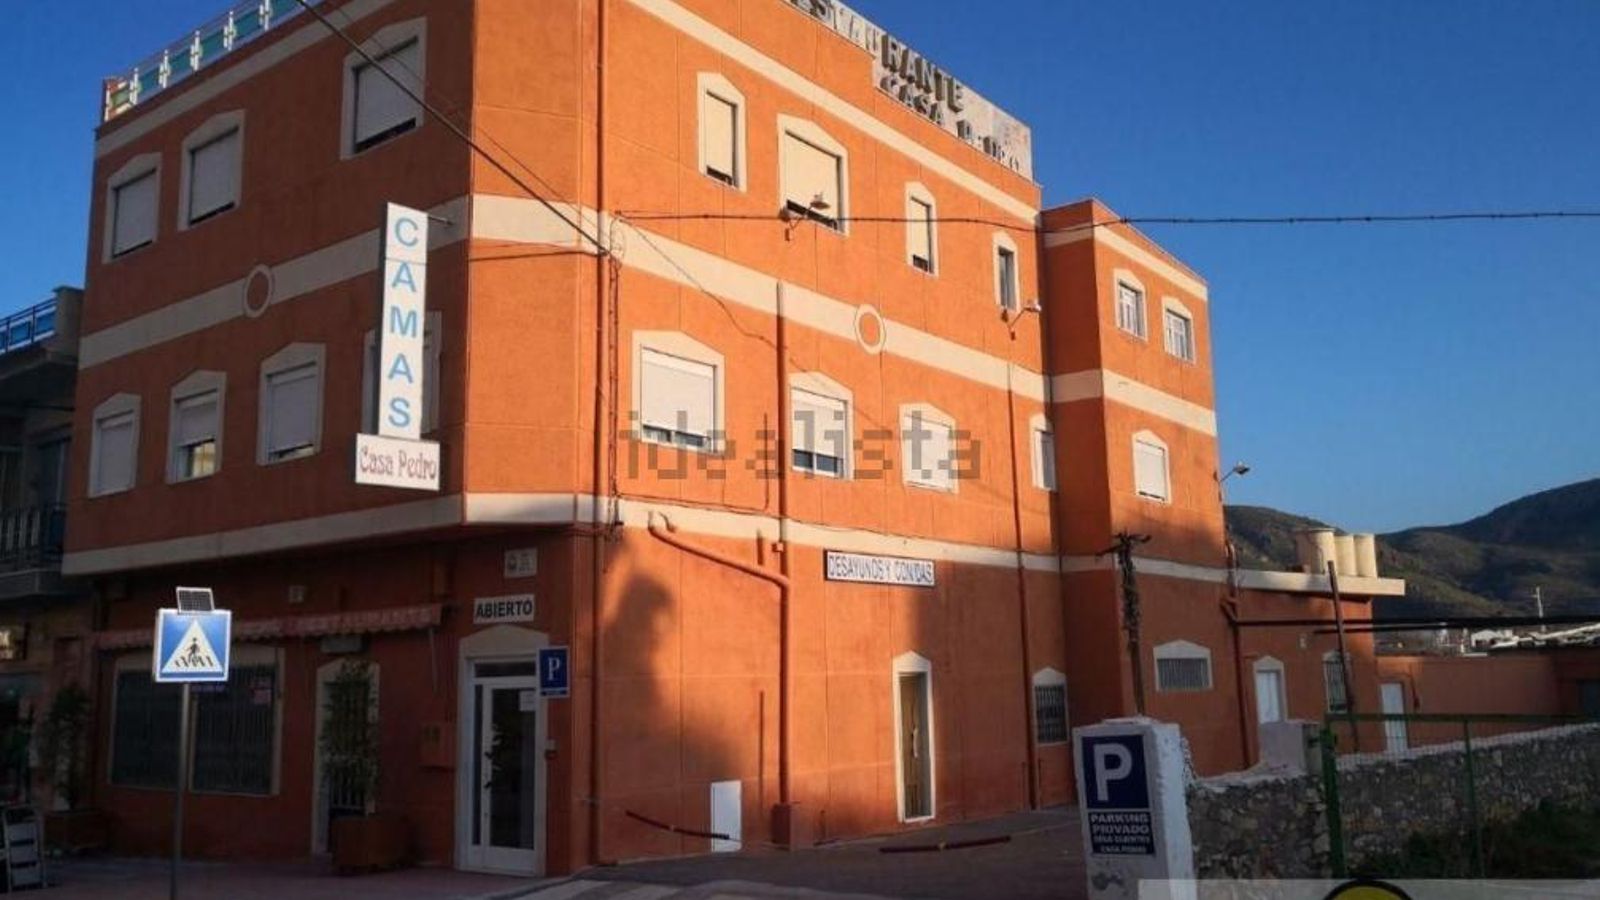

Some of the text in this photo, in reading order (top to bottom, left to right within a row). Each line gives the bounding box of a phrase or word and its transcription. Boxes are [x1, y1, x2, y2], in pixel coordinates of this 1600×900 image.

[387, 217, 419, 427] CAMAS
[359, 447, 437, 480] Casa Pedro
[475, 600, 533, 619] ABIERTO
[548, 656, 561, 681] P
[1093, 743, 1133, 801] P
[1090, 813, 1149, 823] PARKING
[1092, 824, 1150, 834] PRIVADO
